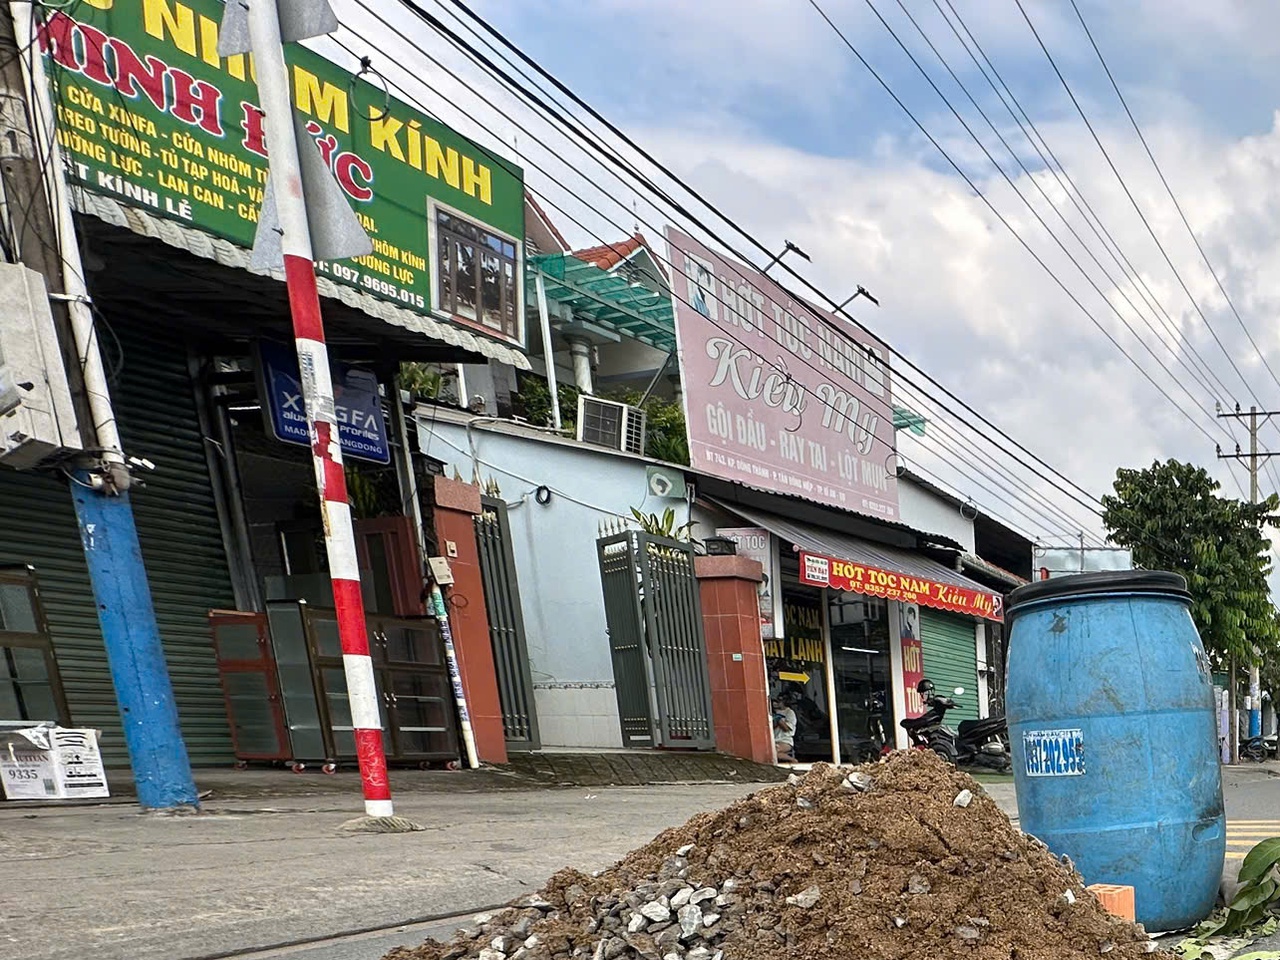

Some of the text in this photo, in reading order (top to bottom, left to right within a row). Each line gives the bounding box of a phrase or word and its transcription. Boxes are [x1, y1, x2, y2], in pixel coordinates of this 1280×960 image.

[66, 85, 105, 116] CỬA
[108, 102, 158, 139] XINFA
[172, 131, 204, 158] CỬA
[207, 146, 251, 180] NHÔM
[369, 104, 492, 206] KÍNH
[98, 169, 425, 309] KÍNH LẺ 097.9695.015
[99, 122, 151, 159] TƯỜNG
[182, 157, 209, 180] TẠP
[401, 250, 426, 272] KÍNH
[111, 151, 143, 176] LỰC
[158, 170, 189, 196] LAN
[193, 185, 225, 210] CAN
[393, 265, 414, 285] LỰC
[721, 275, 765, 338] HỚT
[771, 301, 812, 360] TÓC
[736, 408, 767, 451] ĐẦU
[808, 440, 827, 473] TAI
[861, 458, 888, 494] MỤN
[815, 382, 878, 456] My
[868, 569, 897, 588] TÓC
[900, 577, 930, 595] NAM
[8, 769, 38, 780] 9335
